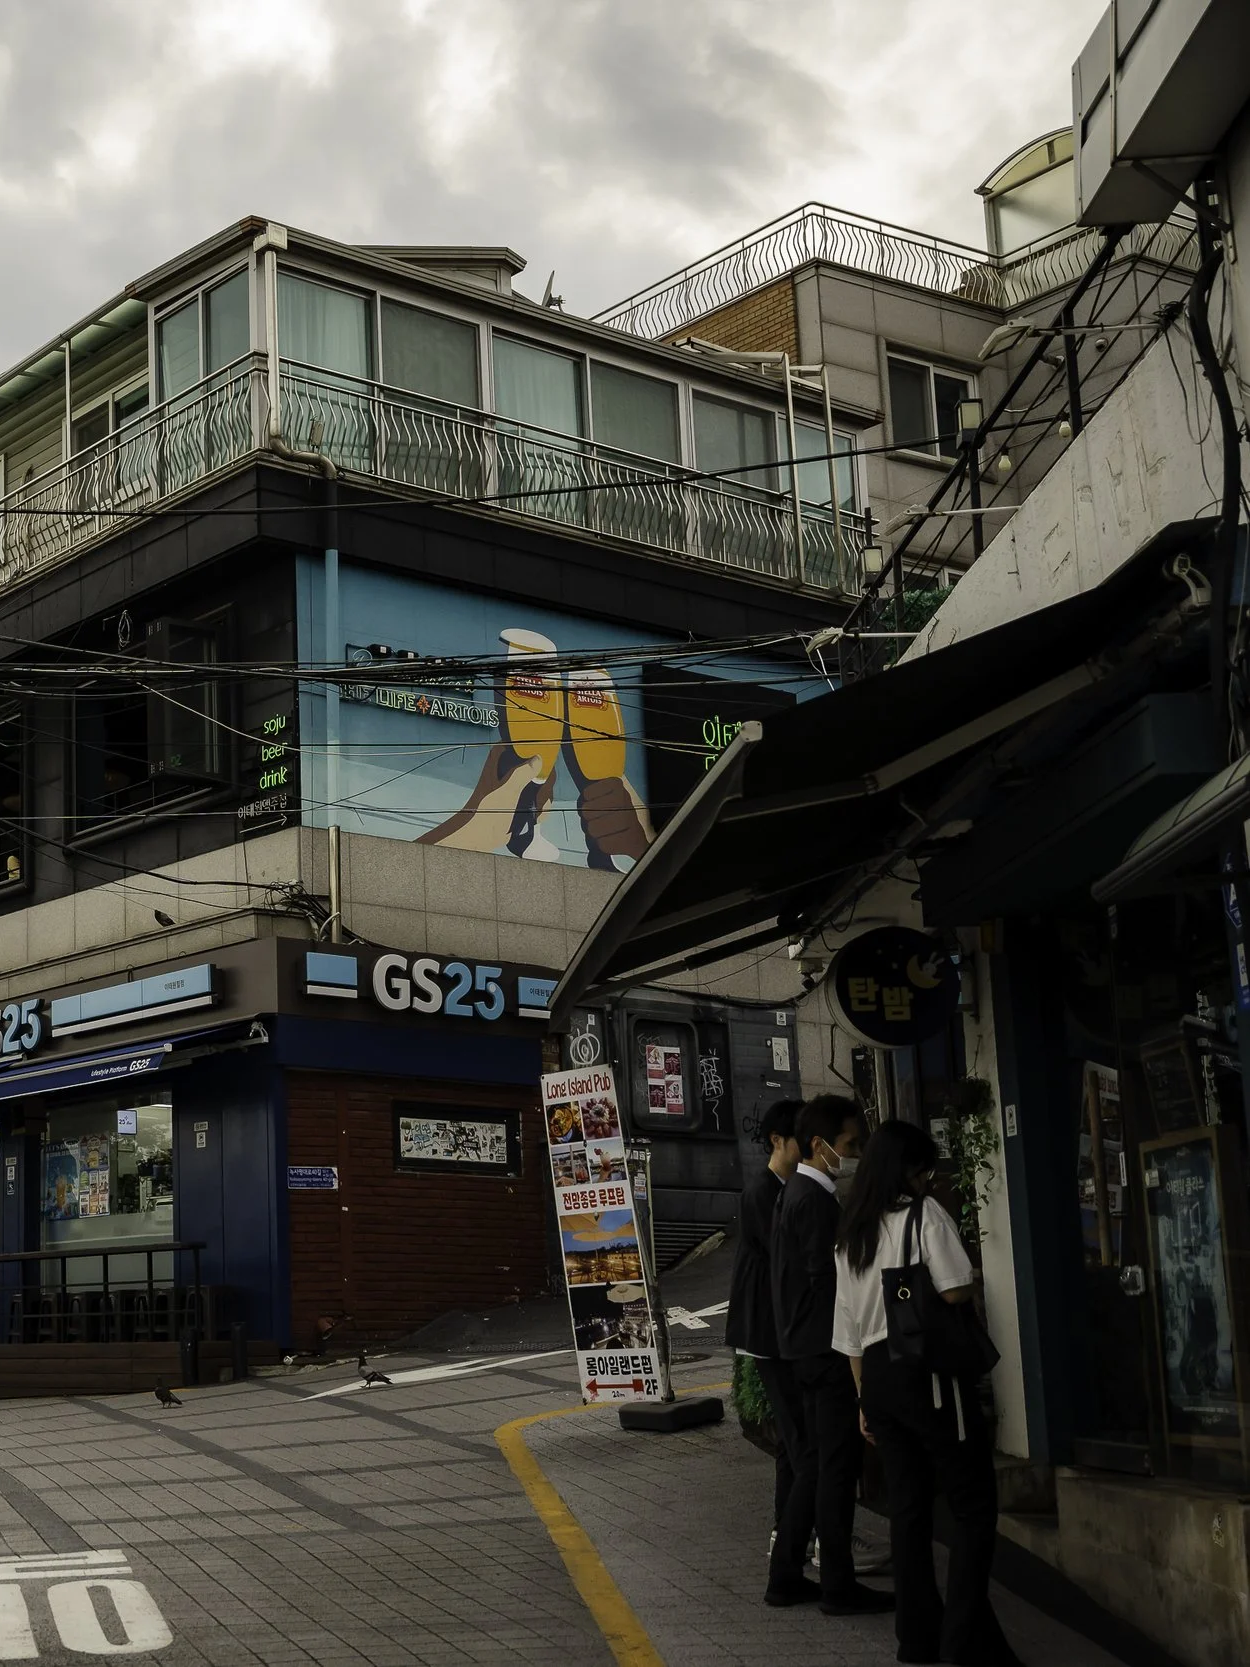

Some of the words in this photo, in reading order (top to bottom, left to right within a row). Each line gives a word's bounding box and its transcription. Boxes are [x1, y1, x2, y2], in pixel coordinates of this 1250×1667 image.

[375, 686, 417, 712] LIFE
[430, 698, 500, 728] ARTOIS
[576, 695, 603, 705] ARTOIS
[263, 713, 287, 736] soju
[261, 742, 288, 762] beer
[259, 765, 288, 790] drink
[237, 793, 288, 820] 이태원맥주집
[372, 953, 506, 1021] GS25
[847, 976, 915, 1022] 탄밤
[90, 1067, 109, 1077] Lifestyle
[109, 1065, 128, 1075] Platform
[129, 1057, 152, 1072] GS25
[546, 1081, 567, 1100] Long
[567, 1074, 593, 1097] Island
[593, 1071, 611, 1093] Pub
[562, 1189, 598, 1211] 전망좋은
[598, 1186, 626, 1207] 루프탑
[585, 1354, 654, 1377] 롱아일랜드펍
[644, 1378, 659, 1396] 2F
